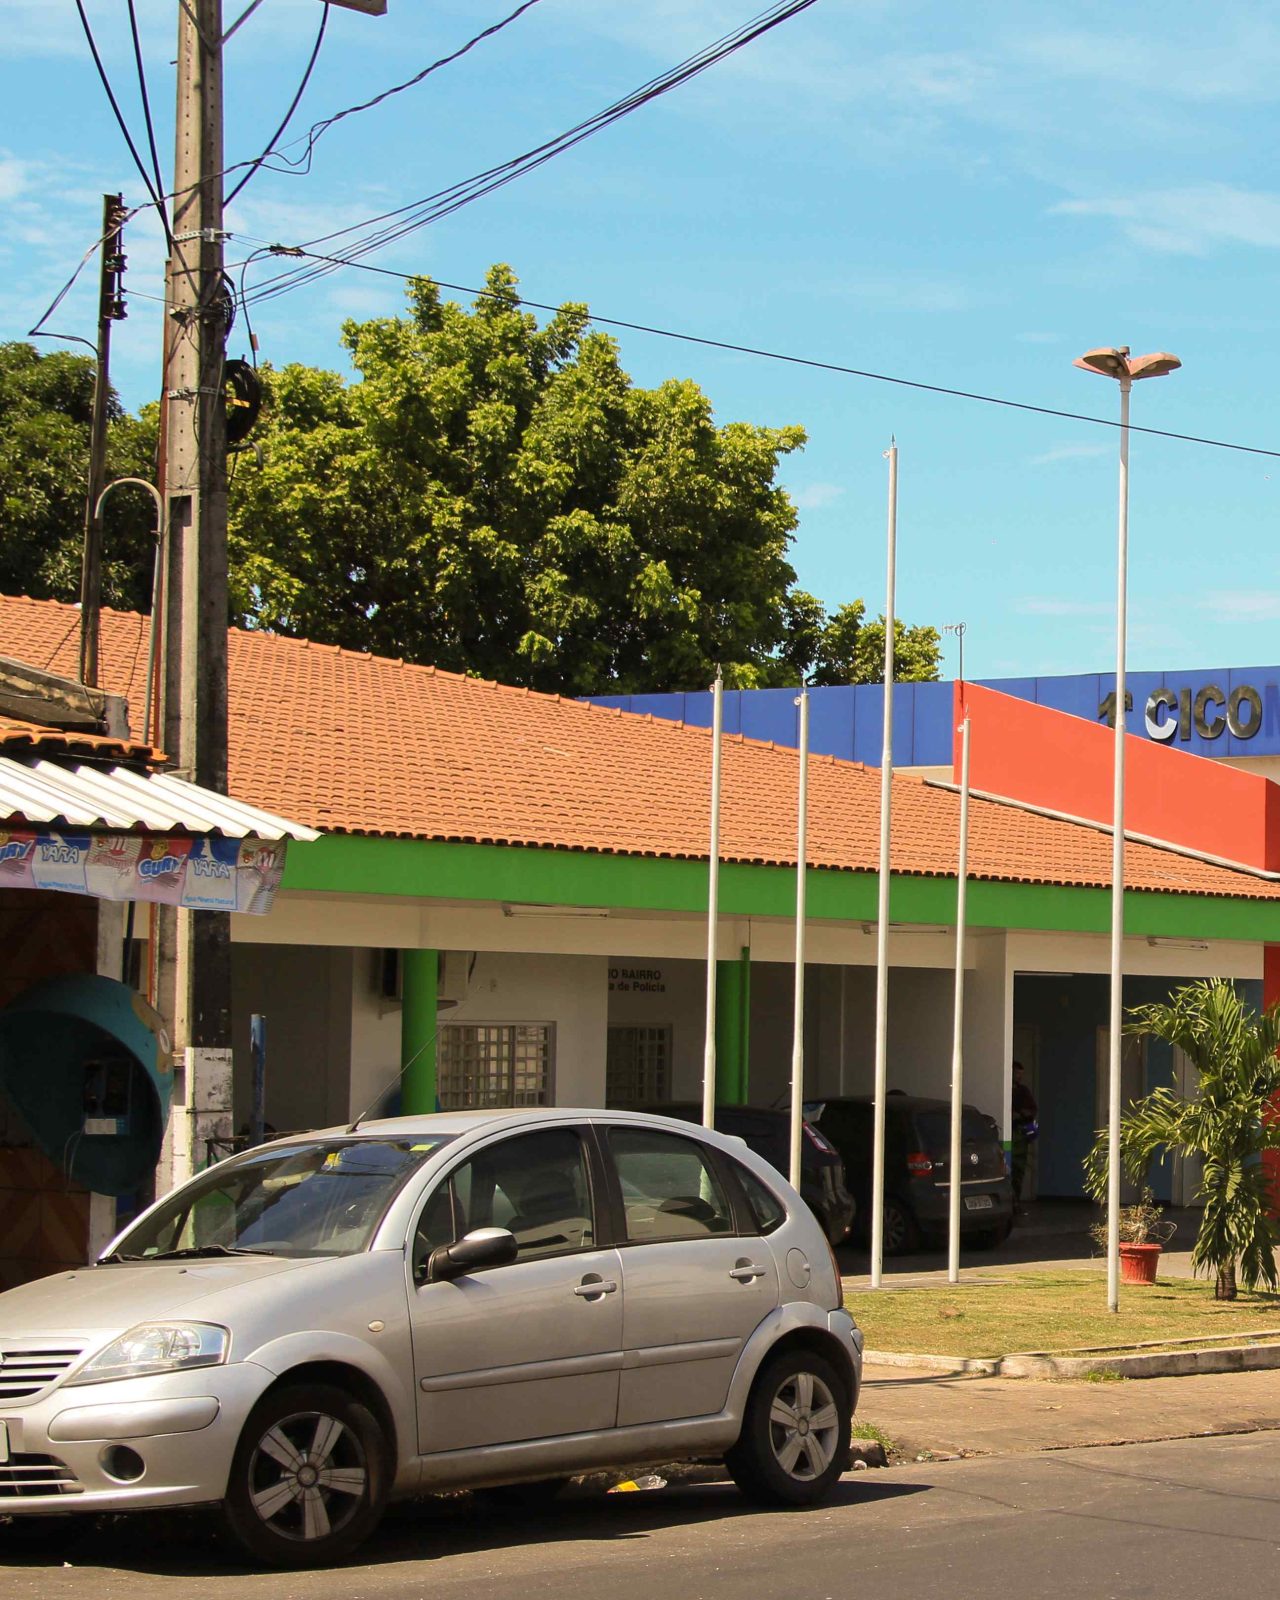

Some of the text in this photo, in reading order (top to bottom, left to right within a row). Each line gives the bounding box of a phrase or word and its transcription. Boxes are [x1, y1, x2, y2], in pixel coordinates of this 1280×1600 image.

[41, 842, 80, 864] YARA
[193, 858, 230, 880] YARA
[621, 969, 662, 980] BAIRRO
